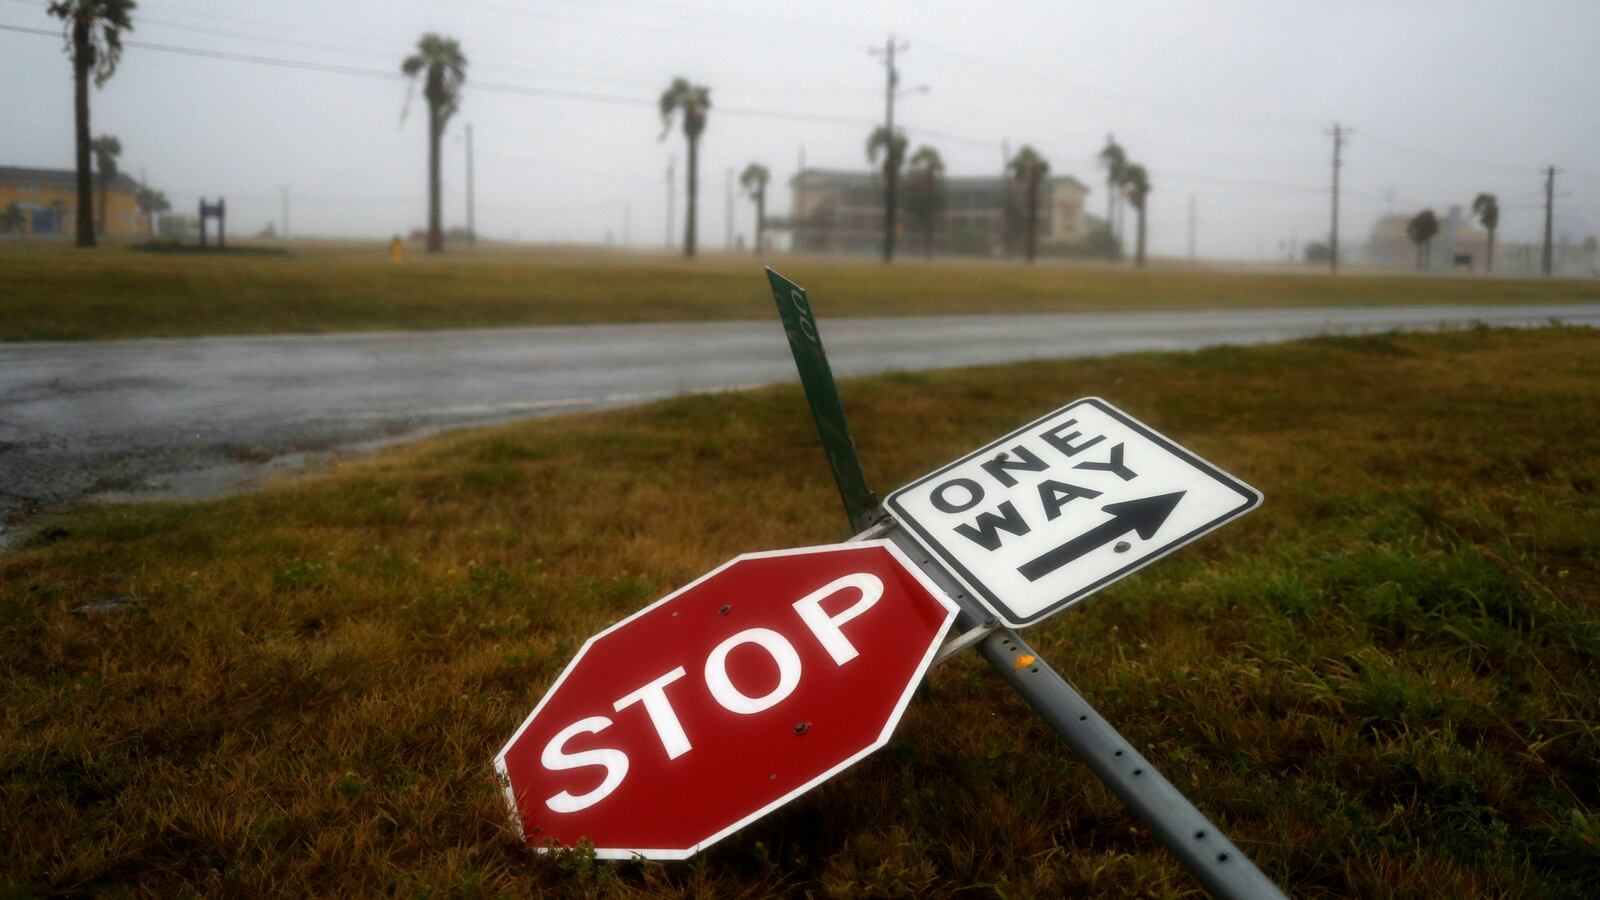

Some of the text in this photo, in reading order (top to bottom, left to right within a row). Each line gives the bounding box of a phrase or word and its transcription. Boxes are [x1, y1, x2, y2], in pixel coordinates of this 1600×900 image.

[930, 418, 1107, 514] ONE
[952, 442, 1138, 552] WAY
[541, 572, 885, 813] STOP
